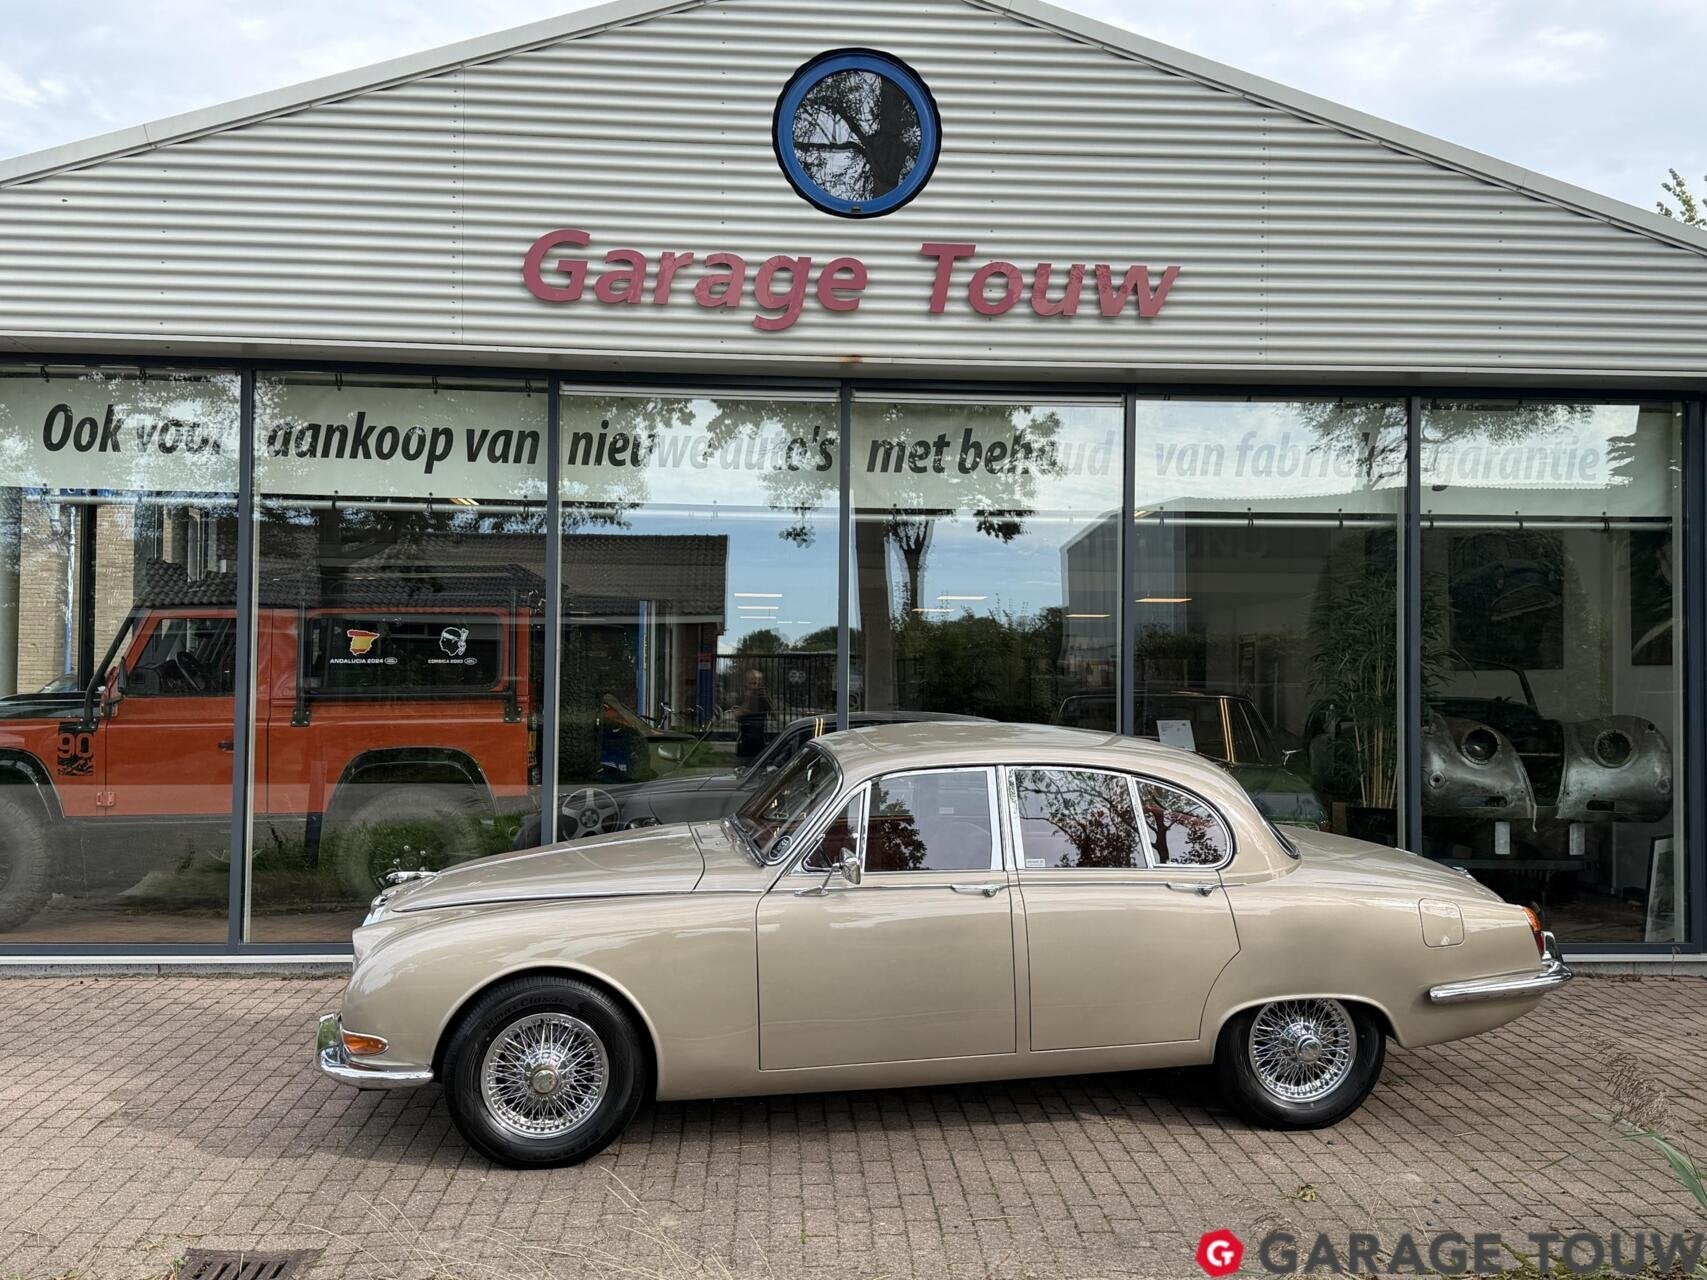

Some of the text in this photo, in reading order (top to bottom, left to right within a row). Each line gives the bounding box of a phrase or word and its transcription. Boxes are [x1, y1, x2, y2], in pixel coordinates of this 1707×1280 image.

[523, 228, 1181, 331] Garage Touw
[43, 403, 122, 452] Ook
[266, 411, 454, 474] aankoop
[466, 428, 540, 464] van
[567, 419, 710, 470] nieuwe
[719, 425, 836, 472] auto's
[866, 432, 950, 474] met
[1154, 442, 1225, 478] van
[1234, 430, 1390, 478] fabriek
[58, 732, 93, 758] 90
